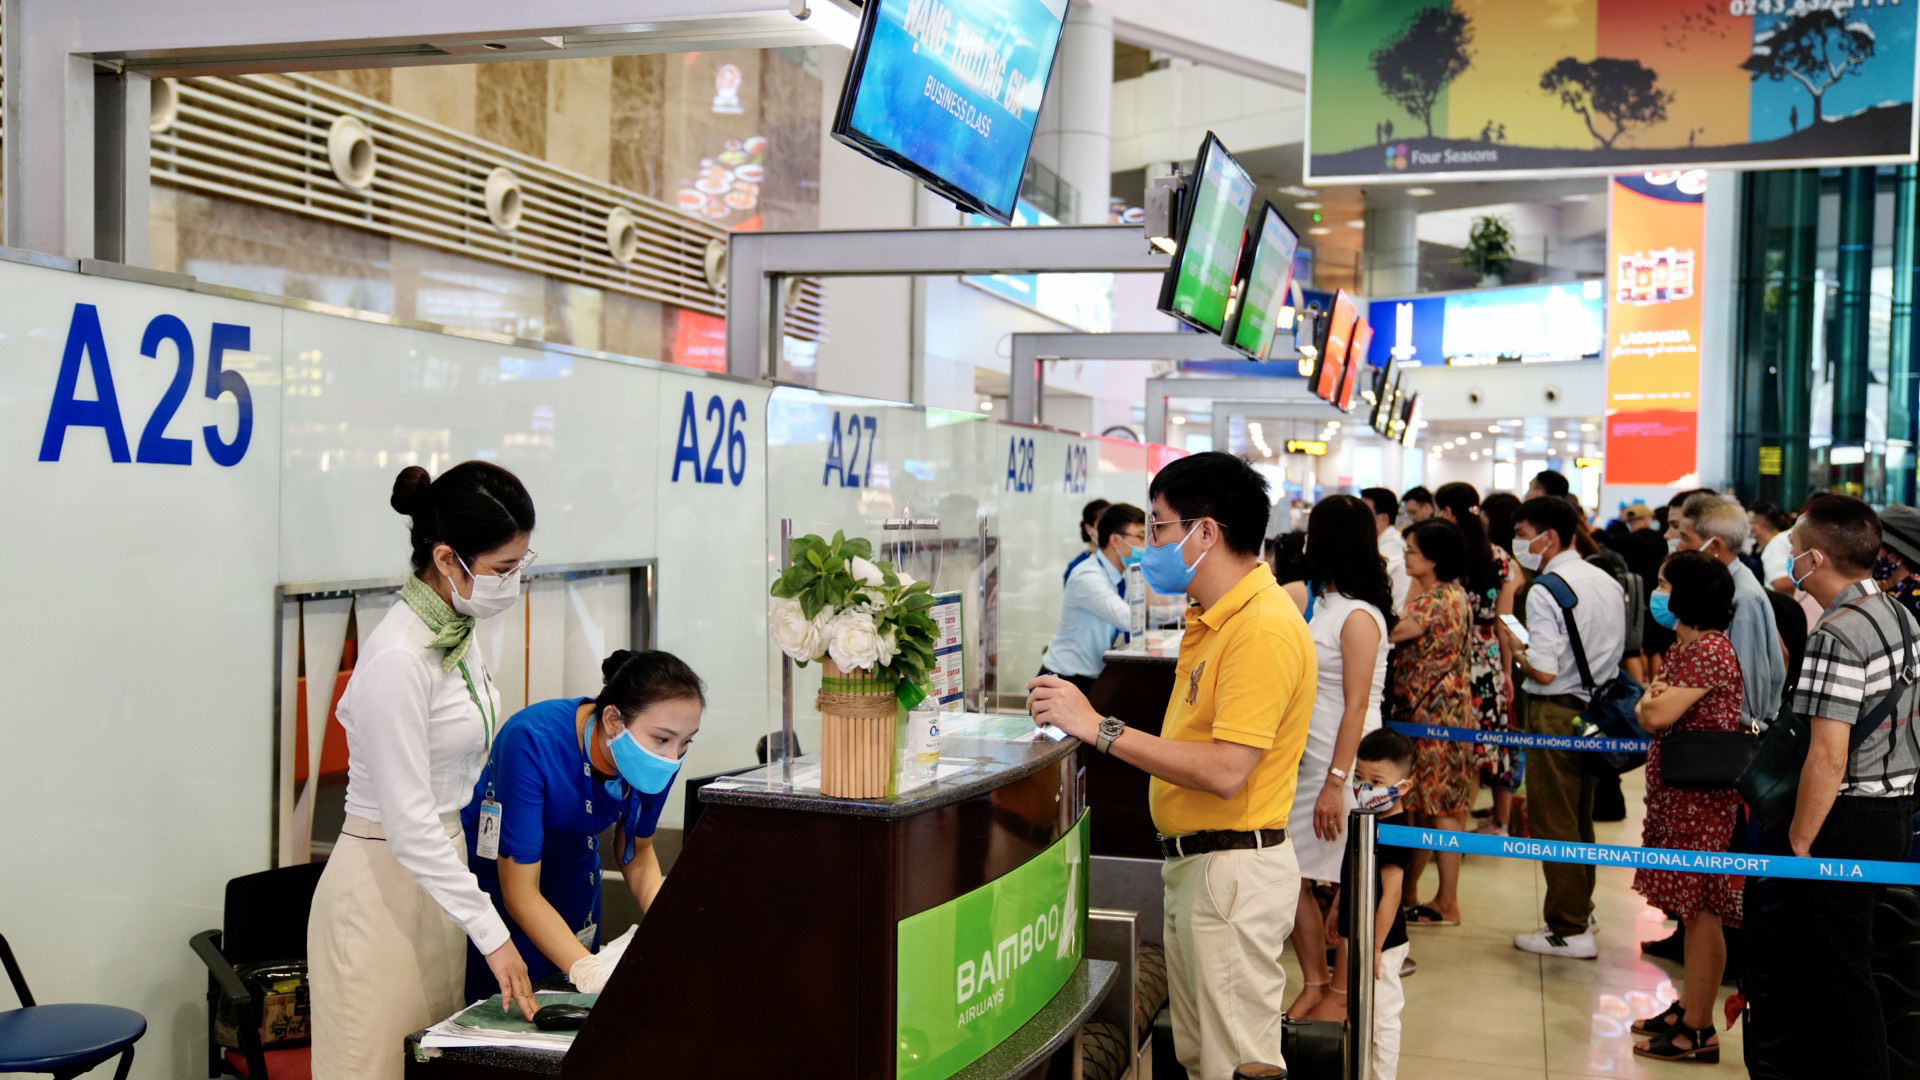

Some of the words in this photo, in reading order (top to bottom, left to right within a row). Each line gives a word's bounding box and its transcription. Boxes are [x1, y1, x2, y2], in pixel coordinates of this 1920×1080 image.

[924, 74, 968, 121] BUSINESS
[965, 105, 992, 138] CLASS
[1411, 150, 1441, 164] Four
[1443, 148, 1498, 164] Seasons
[38, 303, 253, 467] A25
[671, 391, 747, 487] A26
[823, 411, 877, 488] A27
[1006, 436, 1035, 493] A28
[1064, 444, 1087, 493] A29
[1427, 727, 1450, 738] N.I.A
[1422, 832, 1459, 848] N.I.A
[1503, 841, 1557, 857] NOIBAI
[1561, 846, 1690, 867] INTERNATIONAL
[1693, 857, 1770, 872] AIRPORT
[1819, 863, 1863, 878] N.I.A
[957, 904, 1059, 1005] BAMBOO
[957, 988, 1005, 1028] AIRWAYS
